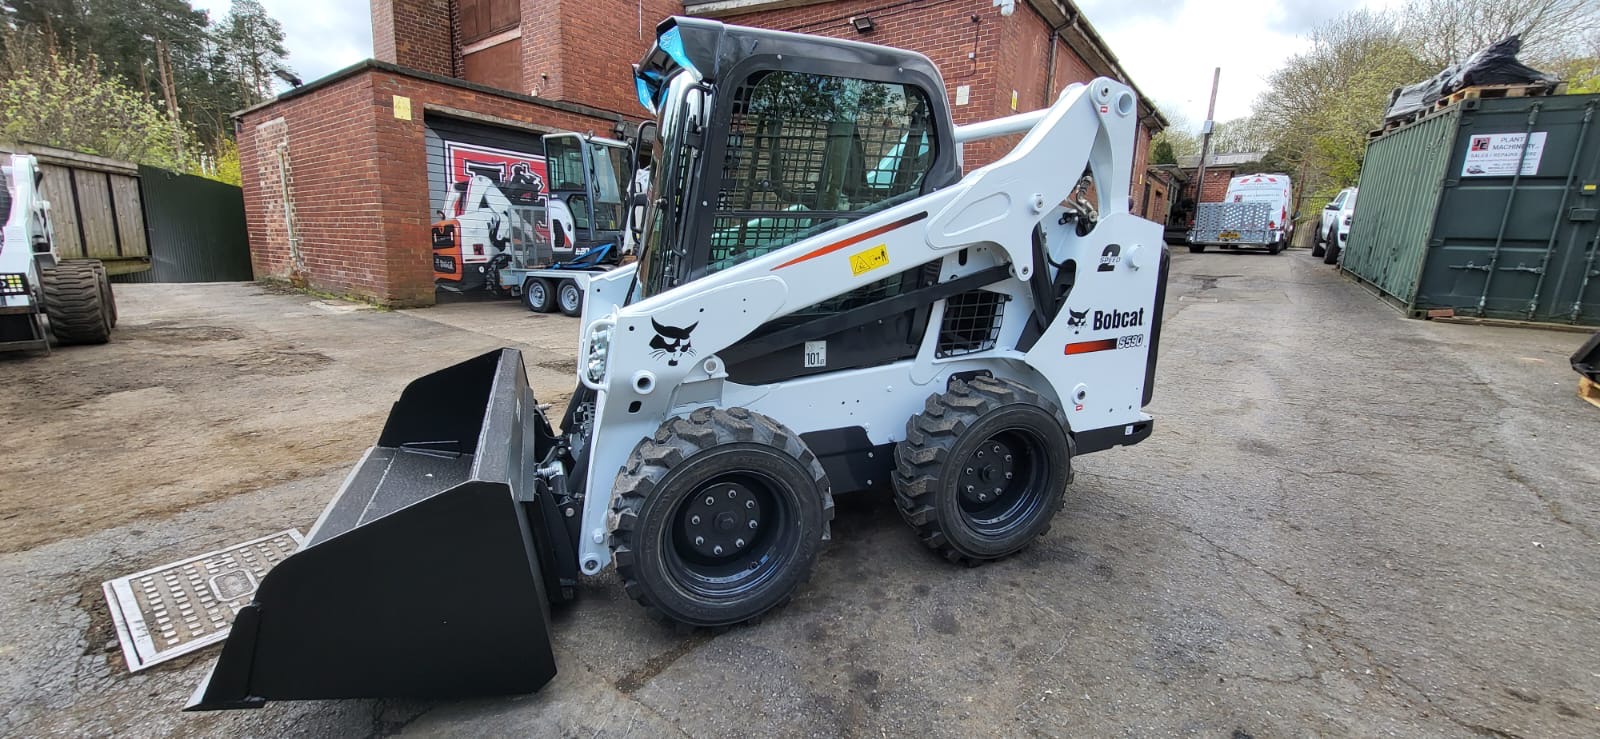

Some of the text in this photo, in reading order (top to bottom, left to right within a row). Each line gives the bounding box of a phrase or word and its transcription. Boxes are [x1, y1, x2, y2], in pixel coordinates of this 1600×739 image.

[1500, 136, 1524, 144] PLANT
[1097, 244, 1121, 272] 2
[1093, 307, 1144, 331] Bobcat
[1118, 334, 1144, 349] S590
[806, 352, 820, 365] 101
